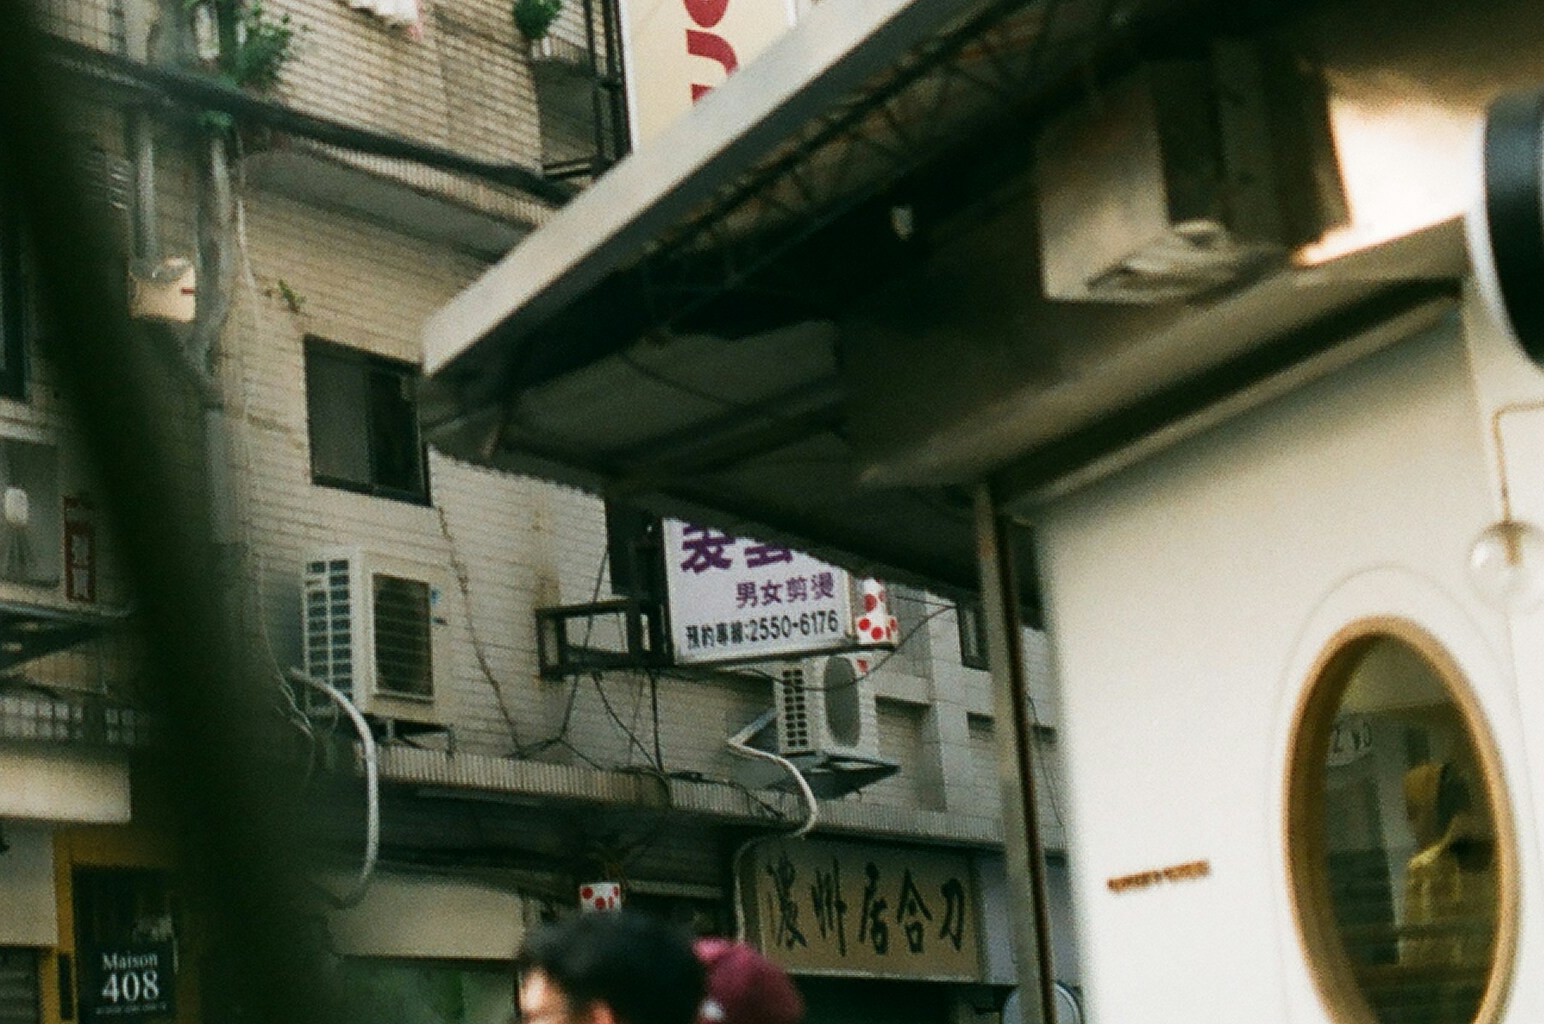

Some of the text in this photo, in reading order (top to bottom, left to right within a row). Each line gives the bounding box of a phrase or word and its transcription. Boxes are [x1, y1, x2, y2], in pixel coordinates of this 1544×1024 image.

[736, 572, 834, 610] 男女剪燙
[102, 951, 158, 971] Maison
[102, 970, 159, 1003] 408
